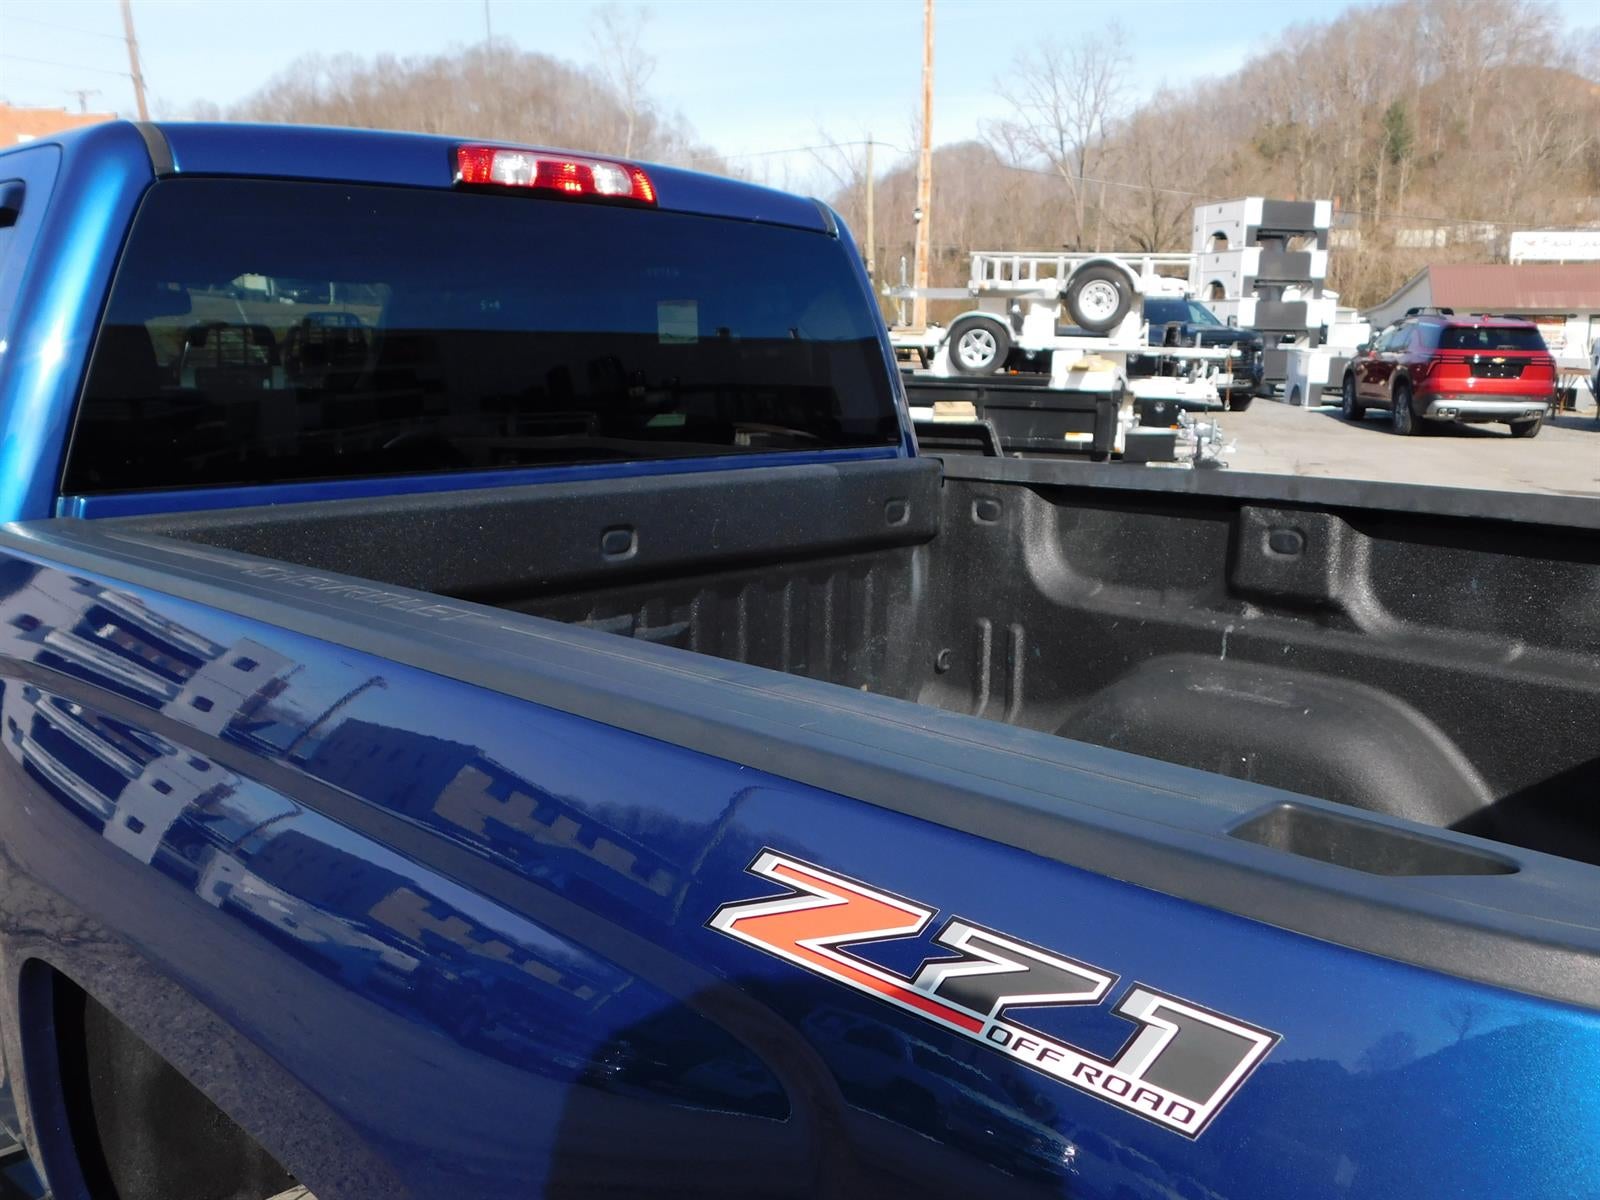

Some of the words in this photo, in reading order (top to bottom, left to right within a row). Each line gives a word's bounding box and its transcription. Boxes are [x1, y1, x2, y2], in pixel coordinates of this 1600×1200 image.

[241, 566, 491, 621] CHEVROLET
[707, 846, 1283, 1112] Z71
[986, 1024, 1065, 1062] OFF
[1072, 1062, 1196, 1125] ROAD
